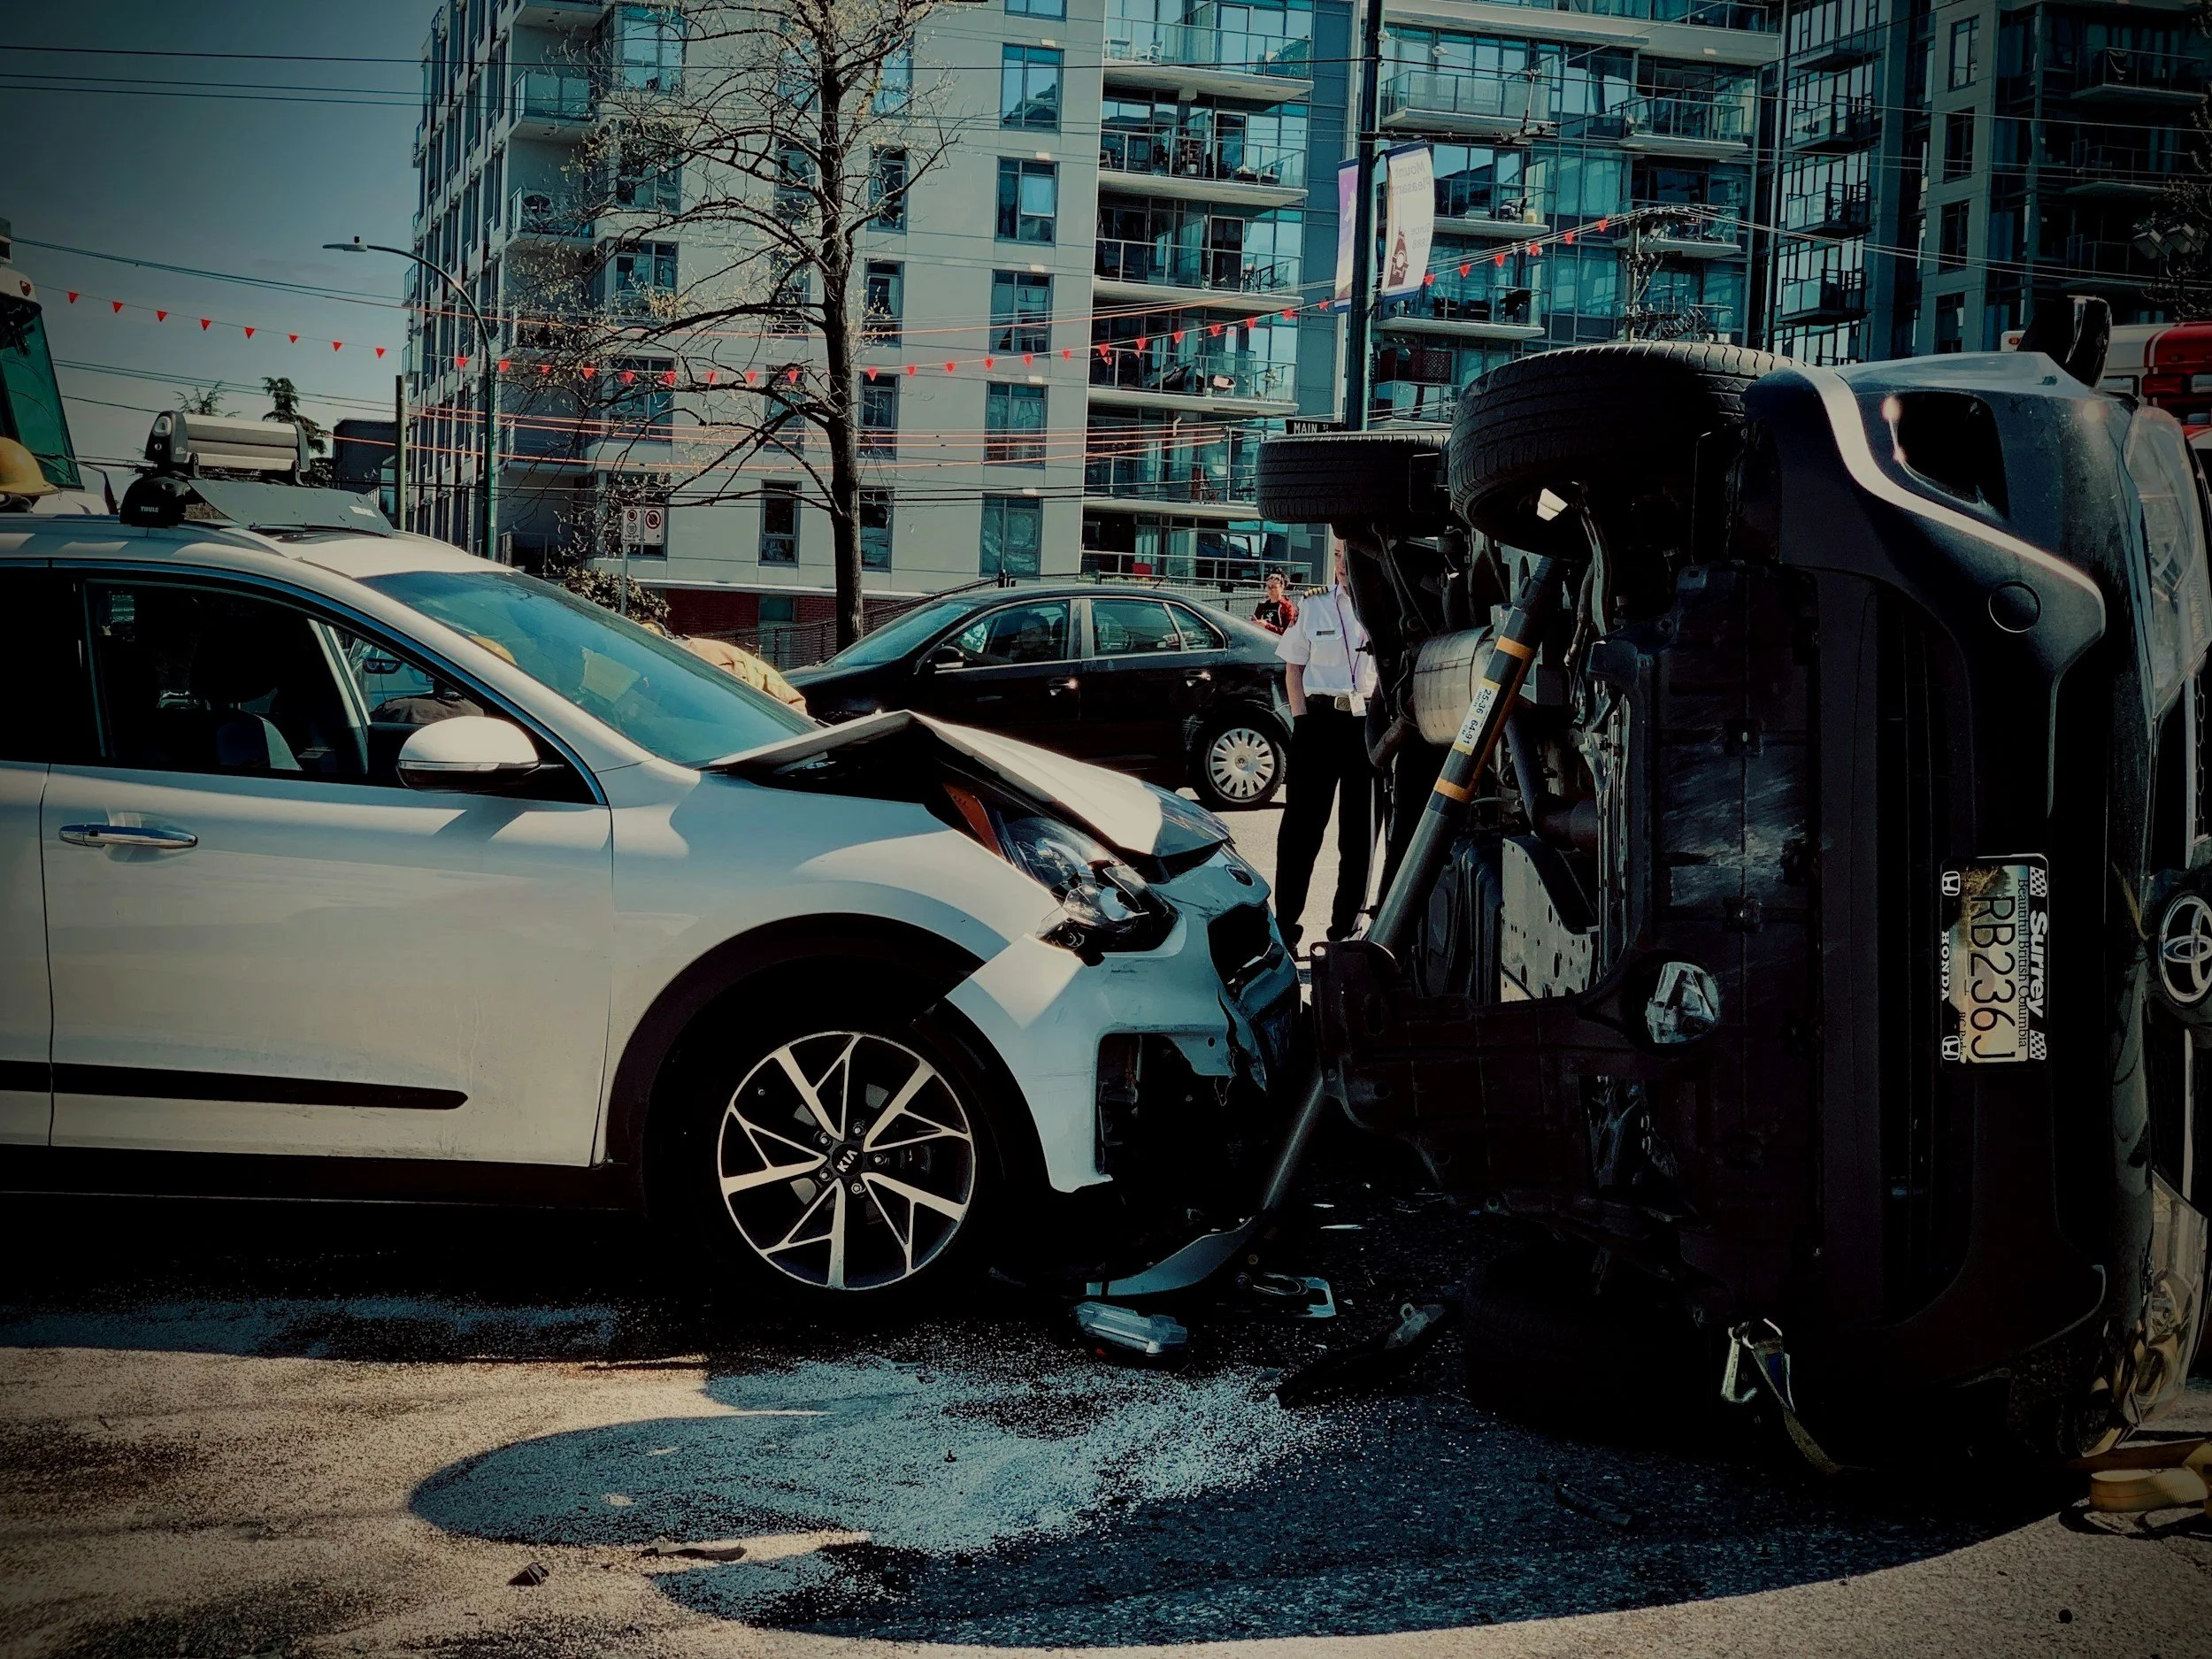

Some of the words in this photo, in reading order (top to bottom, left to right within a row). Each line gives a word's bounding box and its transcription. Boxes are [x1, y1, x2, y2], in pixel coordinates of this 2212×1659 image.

[1294, 422, 1317, 434] MAIN
[1476, 688, 1491, 714] 25-36
[1463, 719, 1478, 744] 64-91
[2017, 878, 2029, 936] Beautiful
[1940, 930, 1950, 1002] HONDA
[1970, 895, 2016, 1059] RB236J
[2017, 941, 2029, 982] British
[2025, 910, 2047, 1018] Surrey
[2017, 986, 2028, 1048] Columbia
[837, 1150, 858, 1172] KIA
